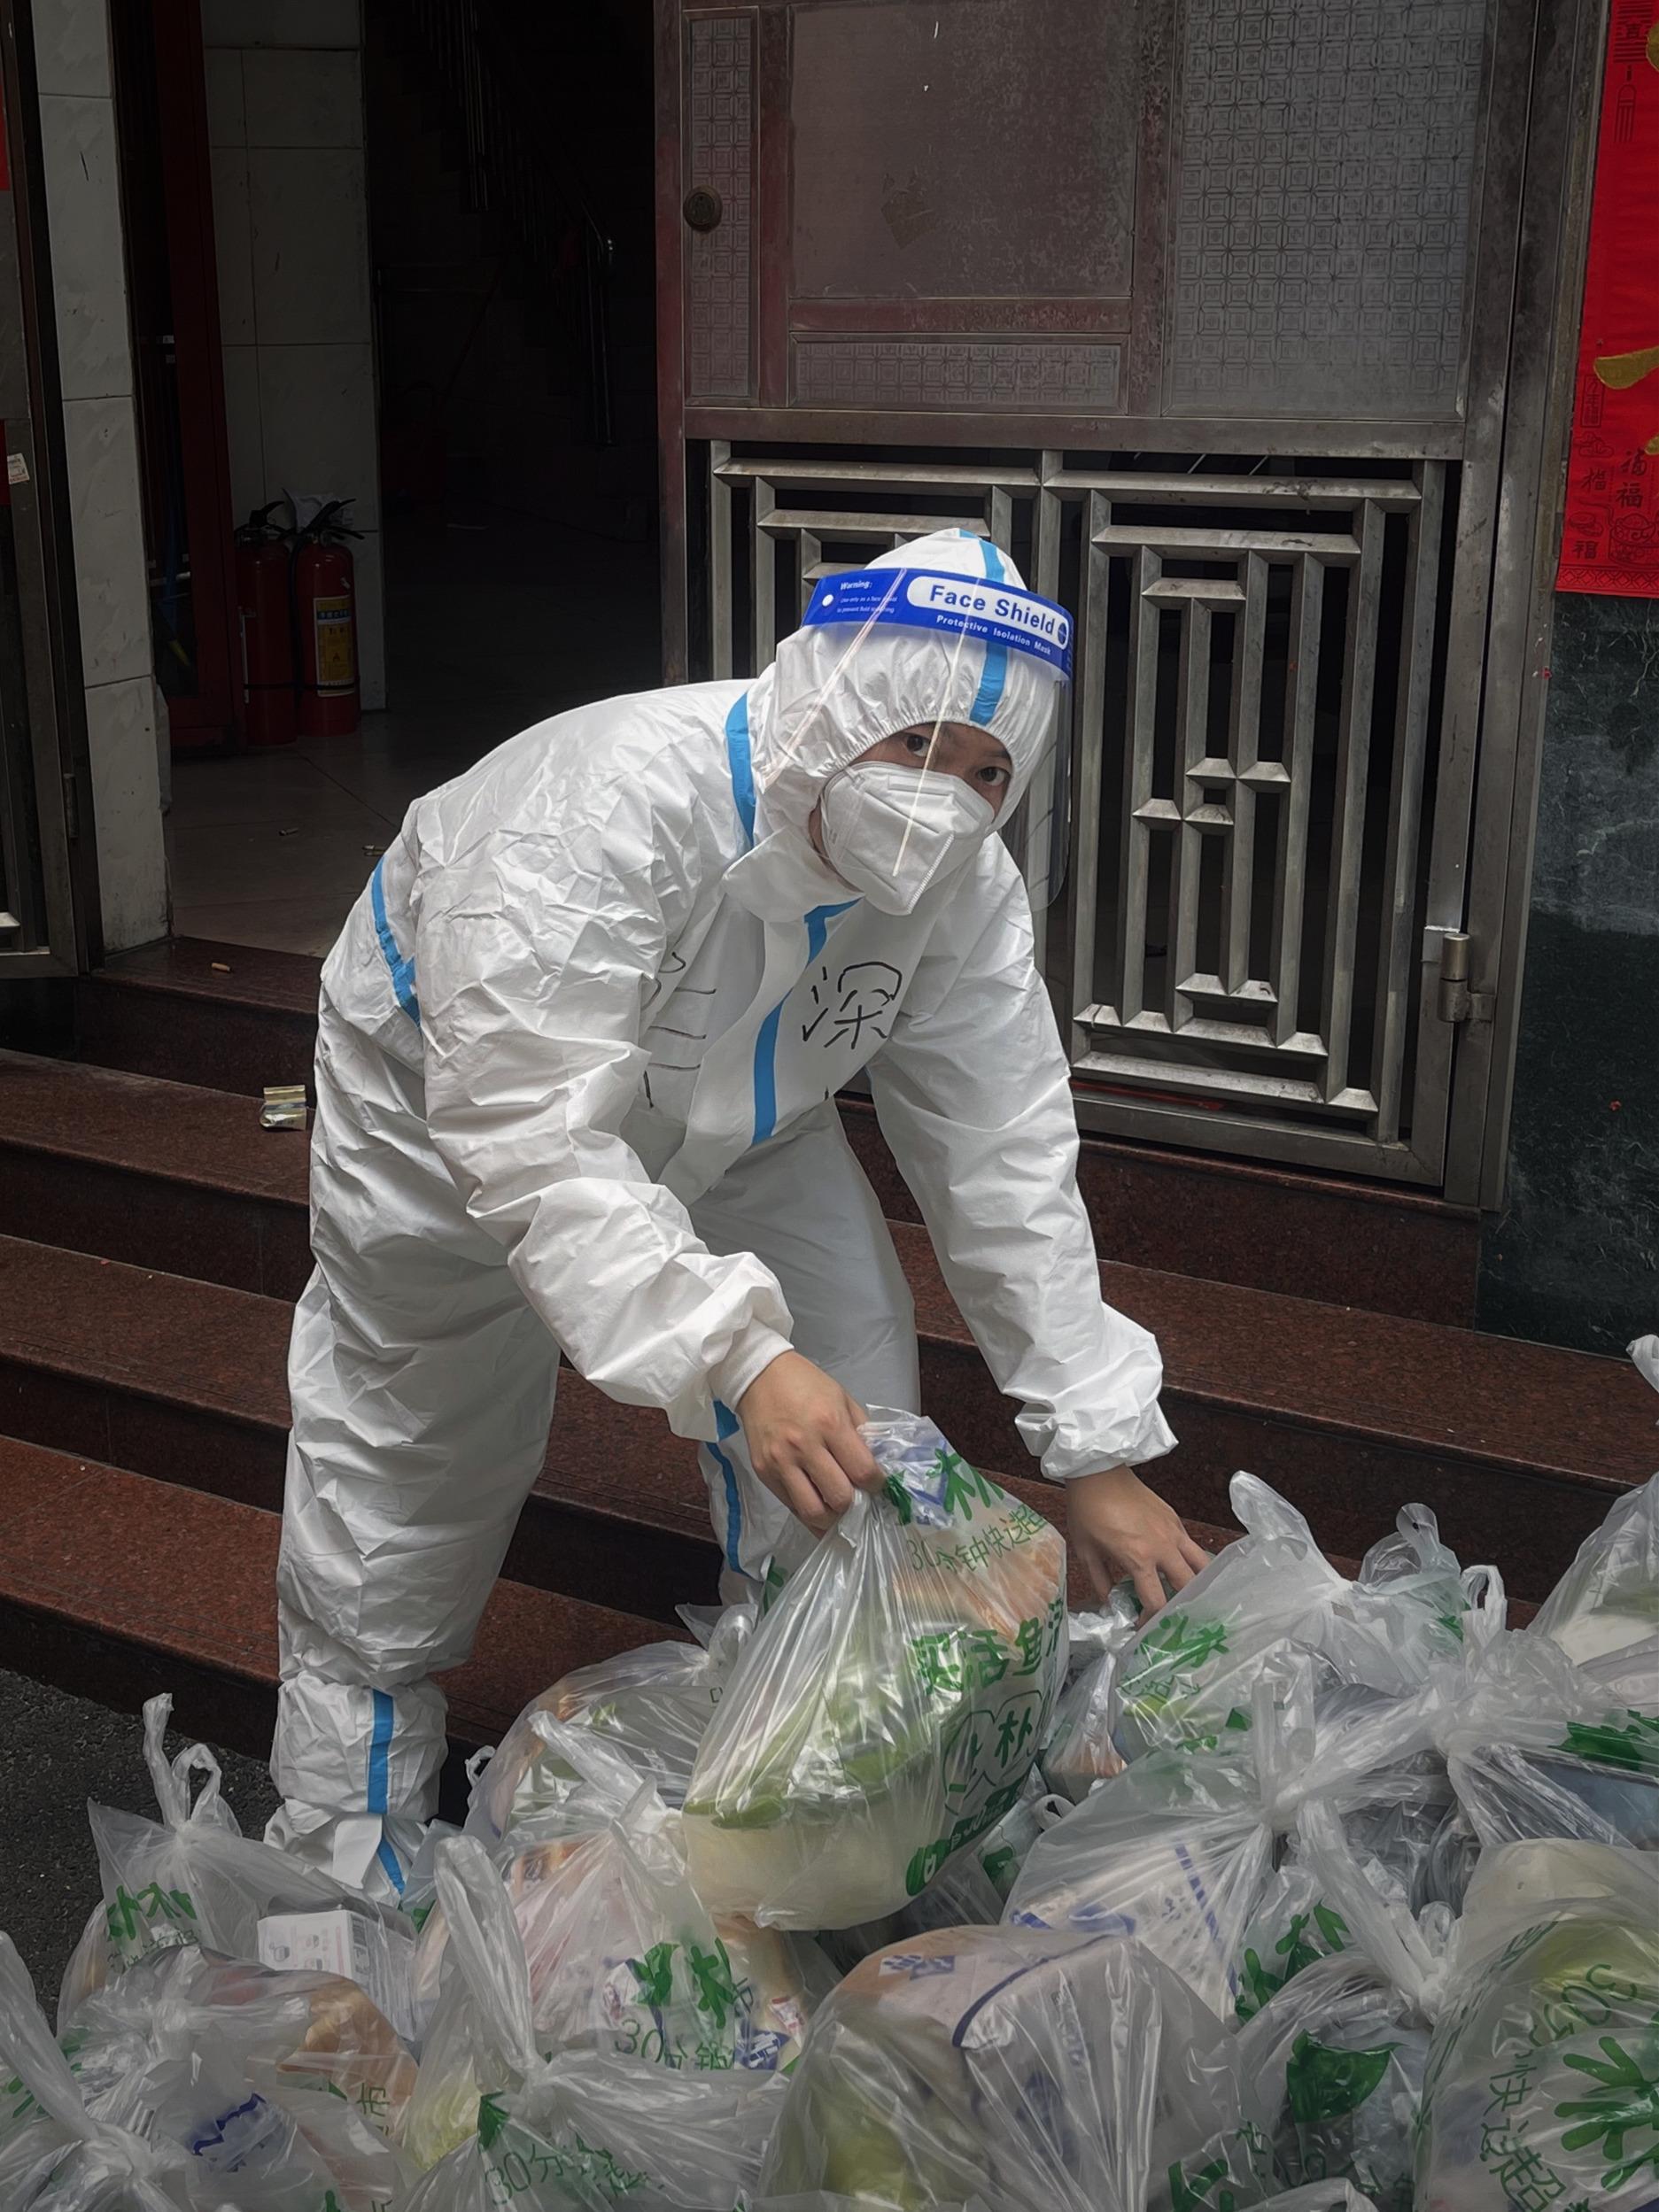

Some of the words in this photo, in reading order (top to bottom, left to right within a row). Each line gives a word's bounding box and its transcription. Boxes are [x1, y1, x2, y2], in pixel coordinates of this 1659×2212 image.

[930, 584, 986, 611] Face
[995, 599, 1056, 636] Shield
[936, 614, 988, 633] Protective
[993, 627, 1030, 646] Isolation
[1034, 640, 1050, 655] Mask
